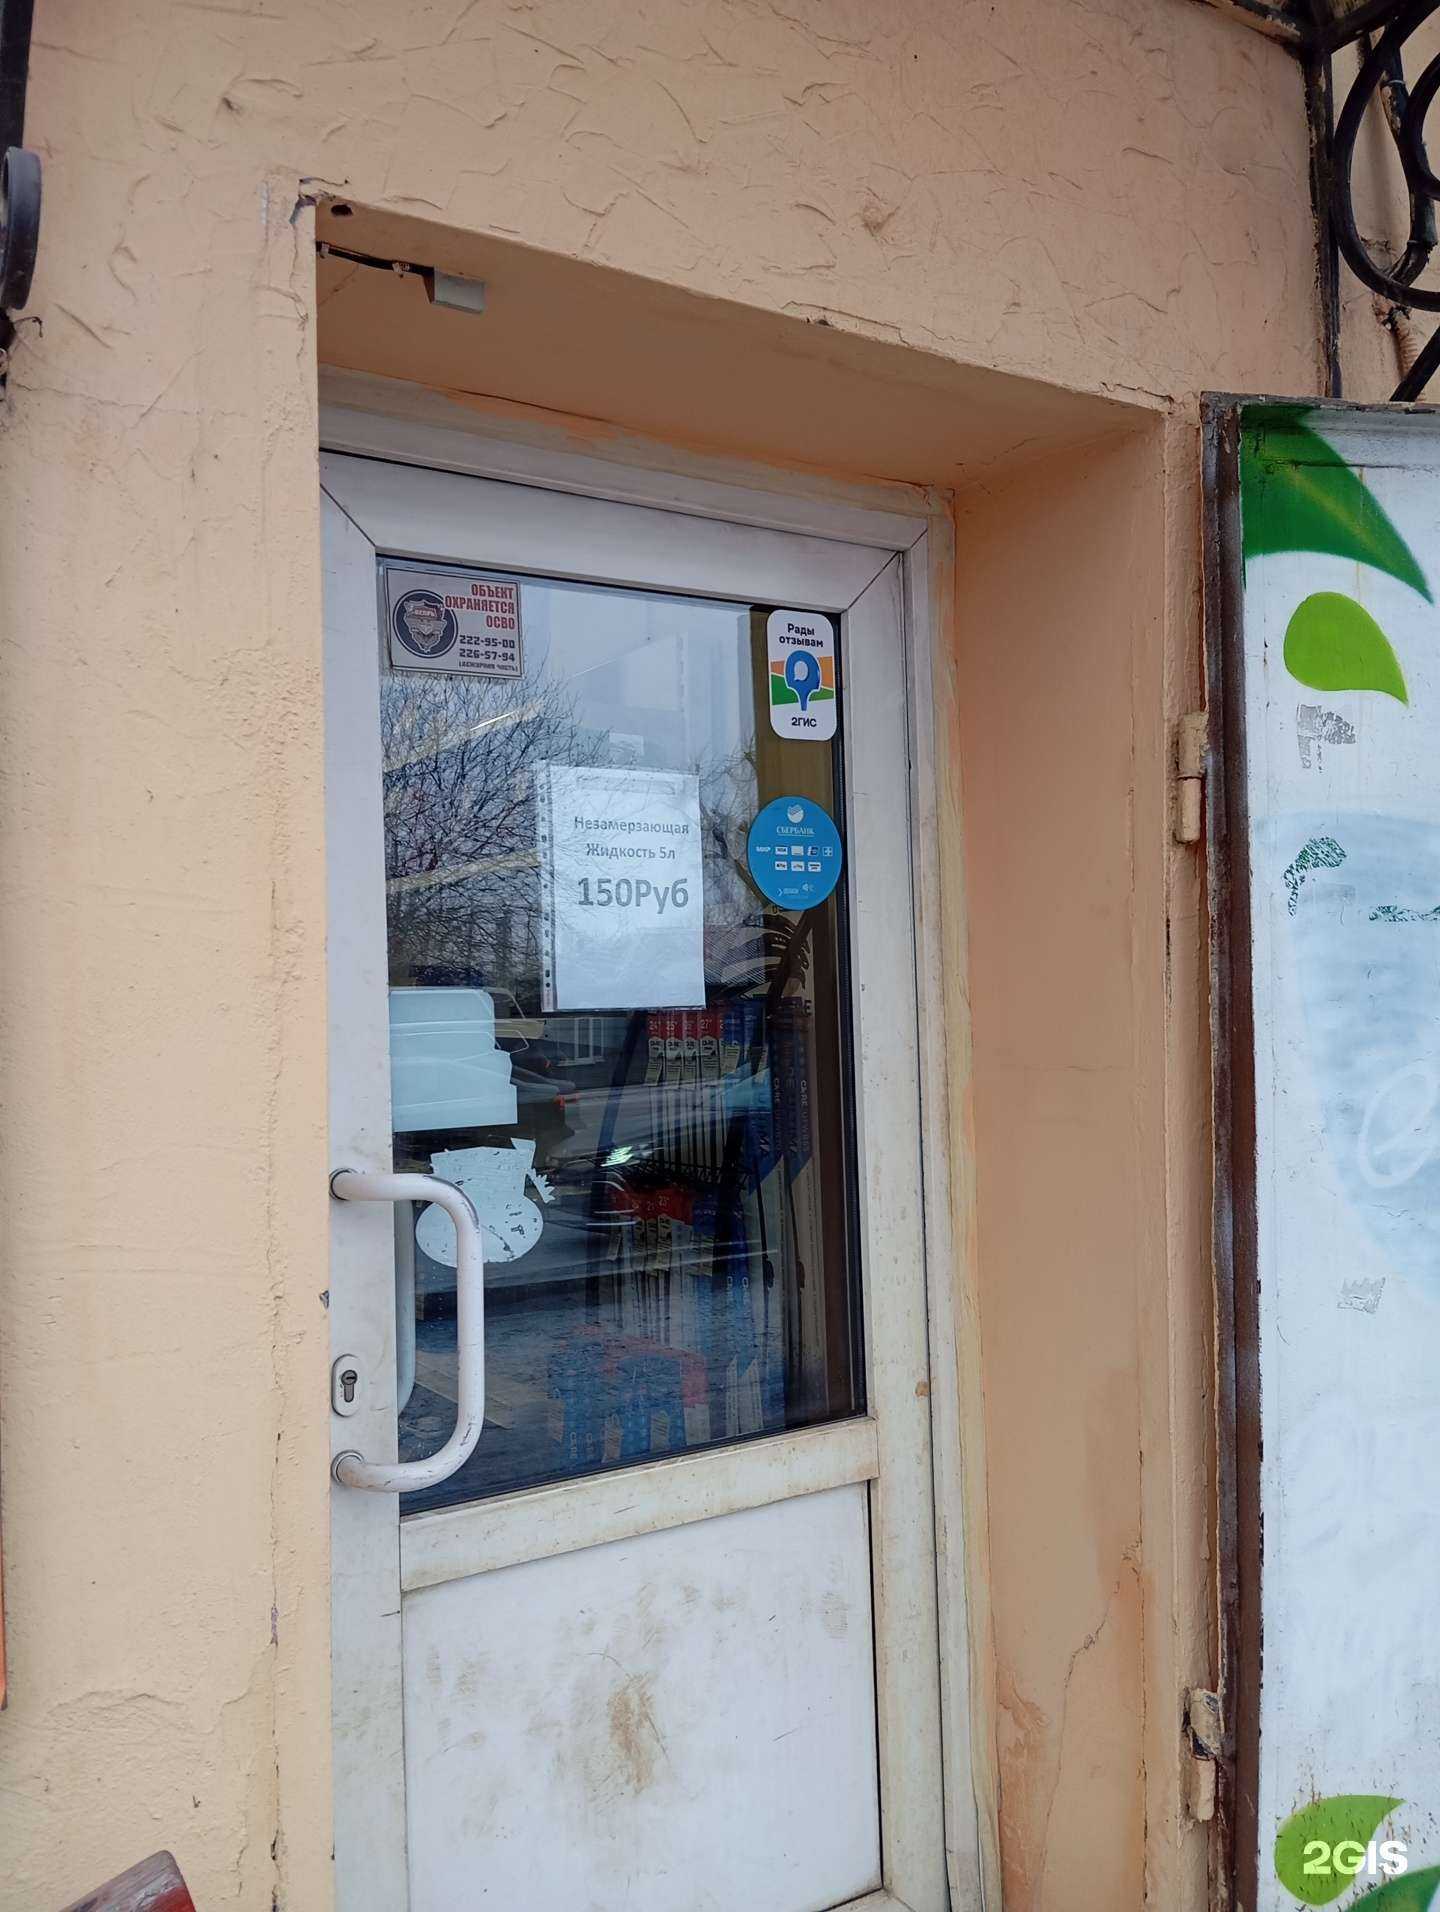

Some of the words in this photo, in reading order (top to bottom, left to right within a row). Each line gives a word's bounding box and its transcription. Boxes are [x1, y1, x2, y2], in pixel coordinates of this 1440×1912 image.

[471, 583, 514, 599] ОБЪЕКТ
[445, 595, 515, 614] ОХРАНЯЕТСЯ
[486, 615, 515, 630] ОСВО
[787, 623, 815, 636] Рады
[459, 635, 515, 649] 222-95-00
[779, 636, 824, 648] отзывам
[459, 649, 515, 662] 226-57-94
[791, 717, 817, 728] 2ГИС
[574, 816, 689, 835] Незамерзающая
[586, 843, 655, 860] Жидкость
[659, 846, 676, 860] 5л
[577, 877, 689, 915] 150Руб
